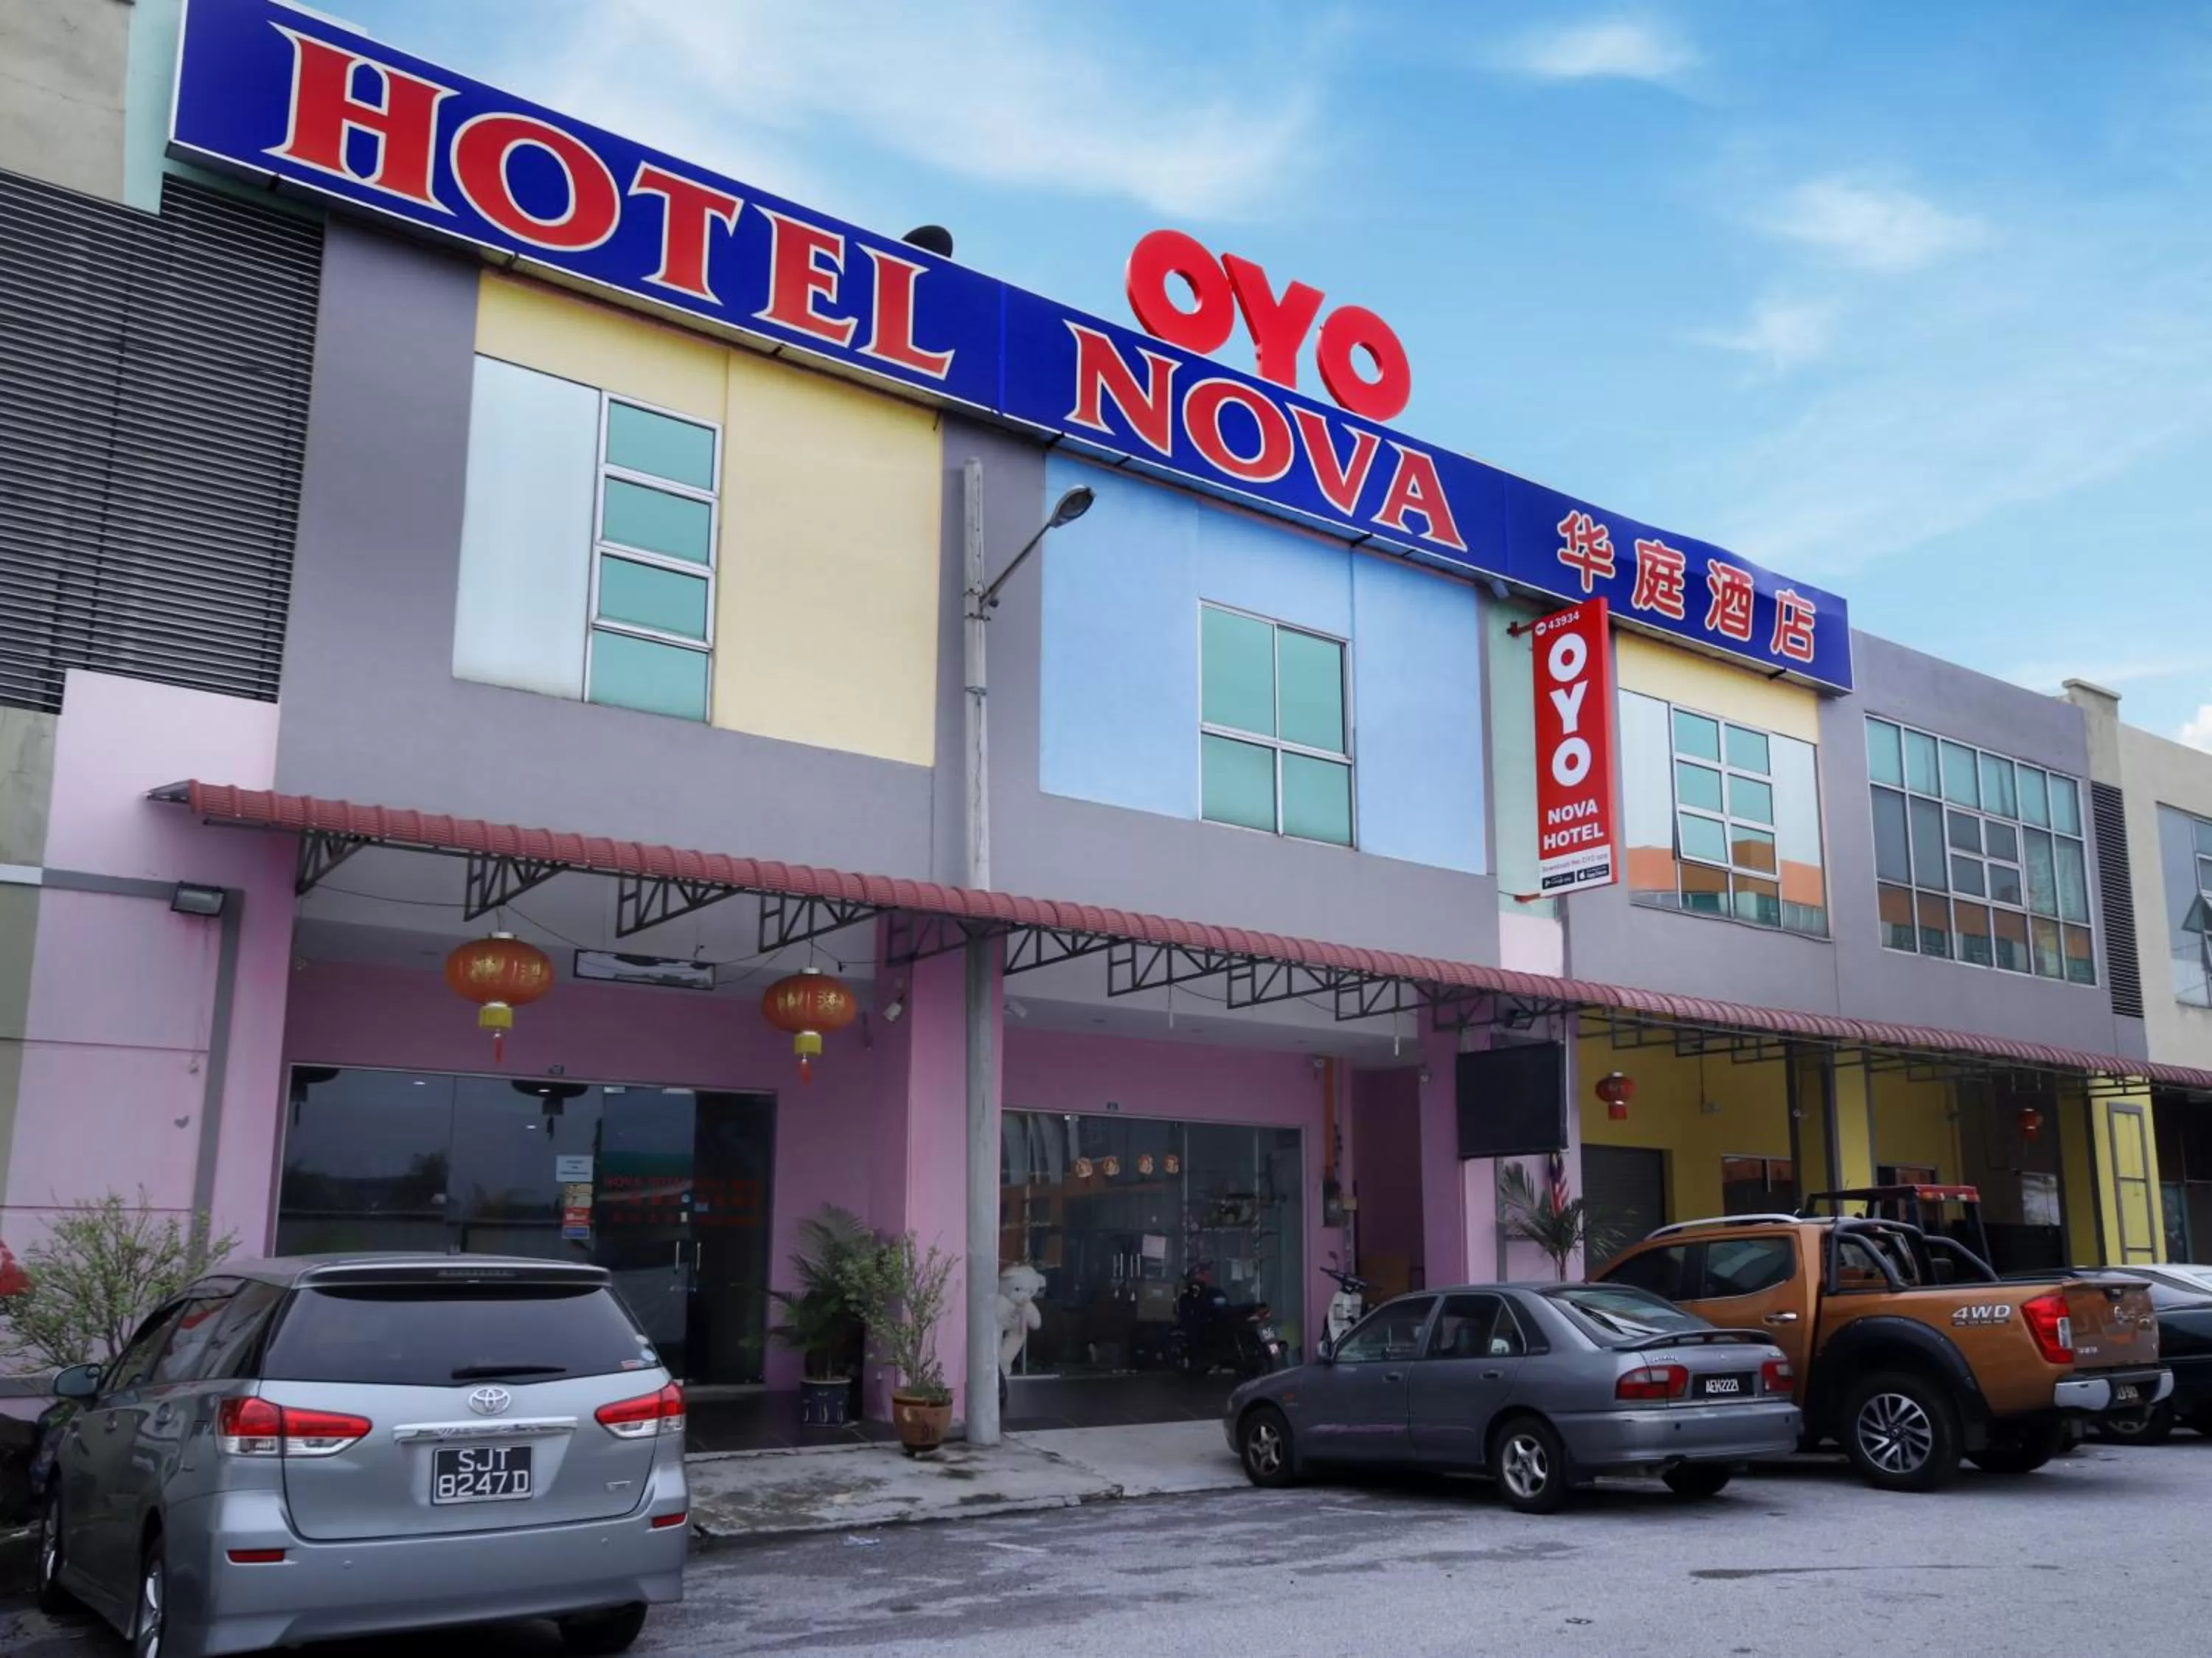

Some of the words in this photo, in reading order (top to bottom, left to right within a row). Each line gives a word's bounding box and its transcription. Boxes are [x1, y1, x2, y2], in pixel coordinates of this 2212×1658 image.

[260, 19, 956, 380] HOTEL
[1125, 229, 1411, 422] OYO
[1062, 319, 1468, 553] NOVA
[1556, 510, 1818, 664] 华庭酒店
[1548, 610, 1580, 629] 43934
[1548, 633, 1592, 787] OYO
[1547, 798, 1599, 826] NOVA
[1543, 822, 1604, 851] HOTEL
[1950, 1303, 2011, 1319] 4WD
[457, 1447, 512, 1472] SJT
[437, 1470, 529, 1498] 8247D
